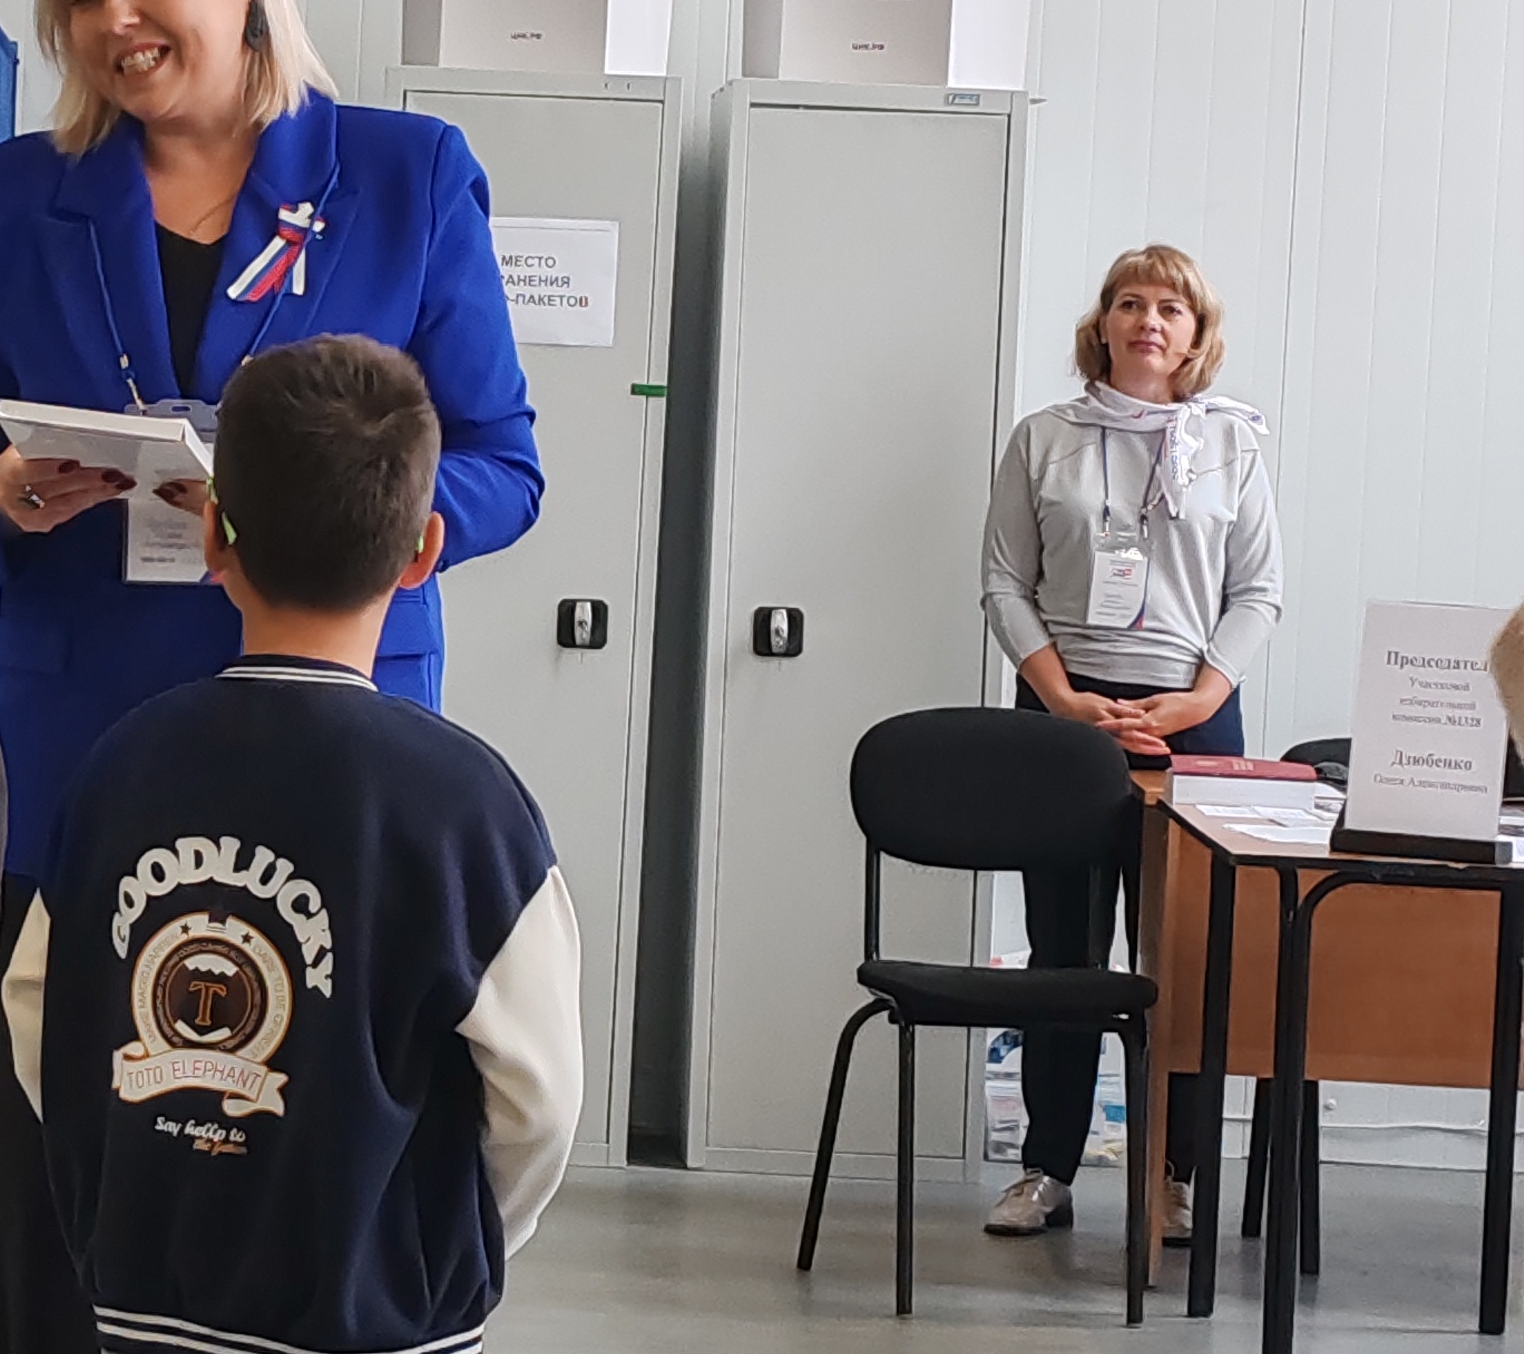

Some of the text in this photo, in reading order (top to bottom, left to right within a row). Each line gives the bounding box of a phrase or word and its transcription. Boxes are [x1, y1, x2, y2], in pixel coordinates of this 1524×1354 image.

[501, 254, 557, 269] МЕСТО
[501, 274, 571, 288] АНЕНИЯ
[505, 293, 589, 308] -ПАКЕТОВ
[1386, 650, 1490, 672] Председател
[189, 981, 226, 1026] T
[127, 1060, 262, 1091] TOTO ELEPHANT
